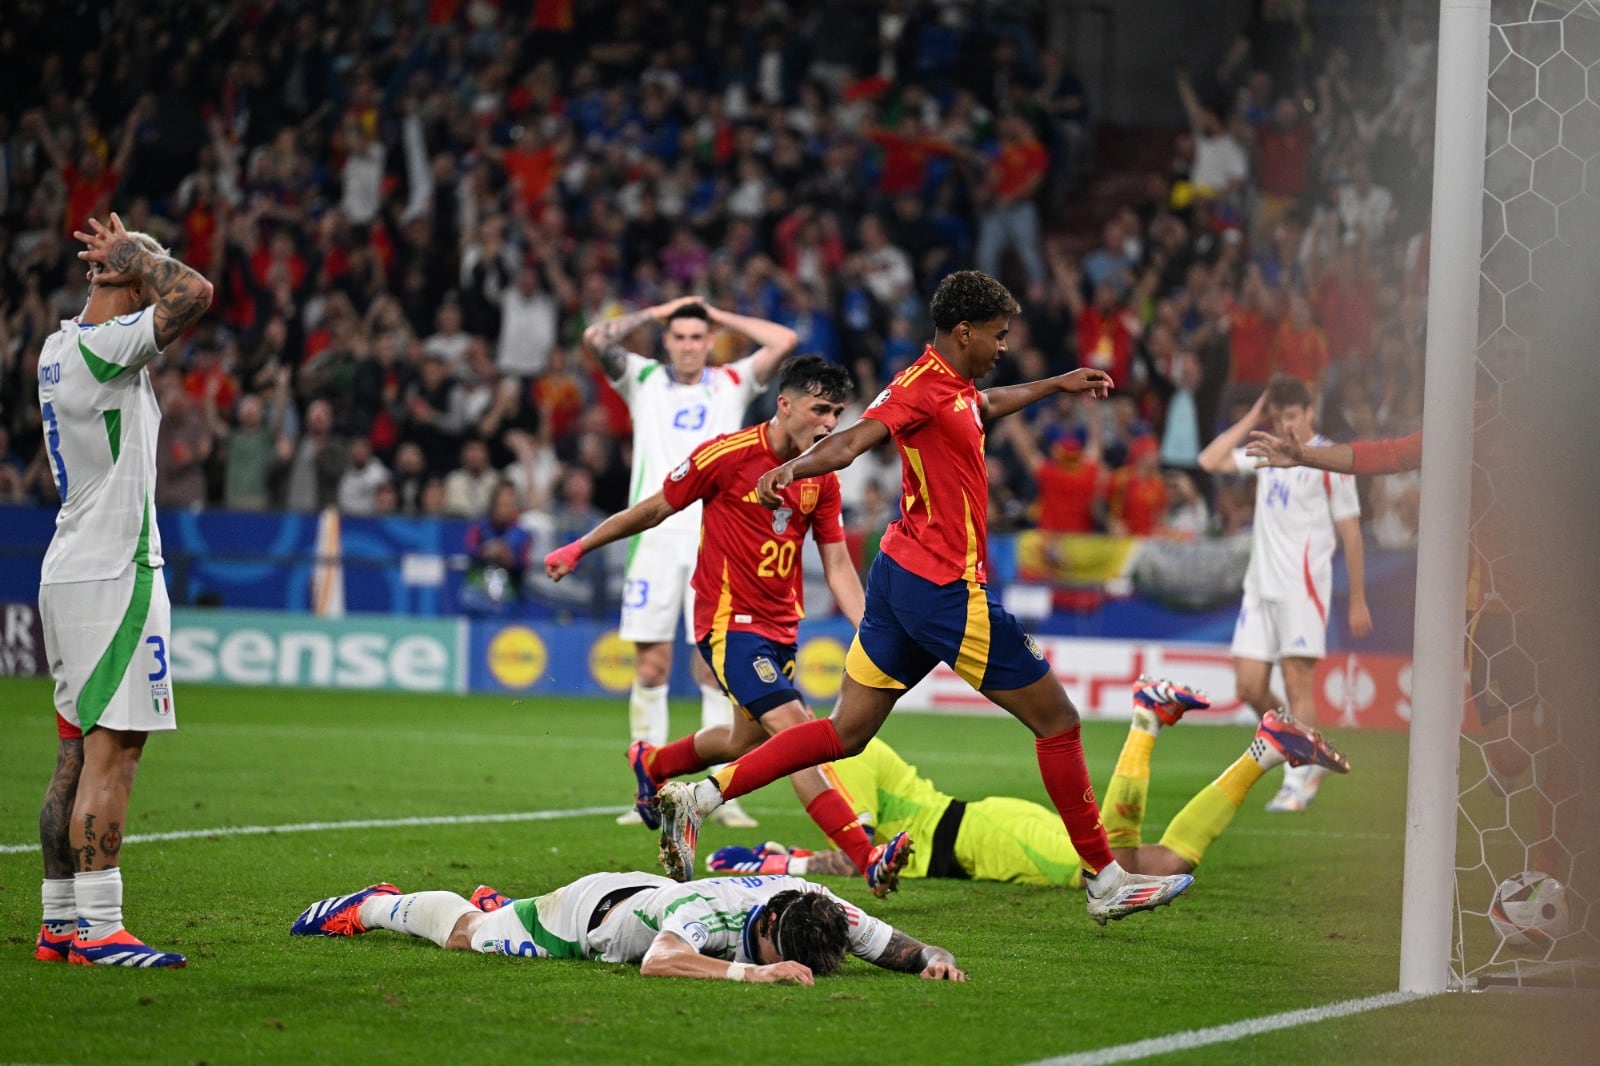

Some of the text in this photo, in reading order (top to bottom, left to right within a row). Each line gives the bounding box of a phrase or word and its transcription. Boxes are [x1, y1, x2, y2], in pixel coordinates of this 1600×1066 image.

[673, 403, 706, 430] 23
[42, 401, 69, 503] 3
[1265, 478, 1291, 509] 24
[757, 539, 796, 577] 20
[145, 635, 168, 681] 3
[169, 624, 449, 690] sense
